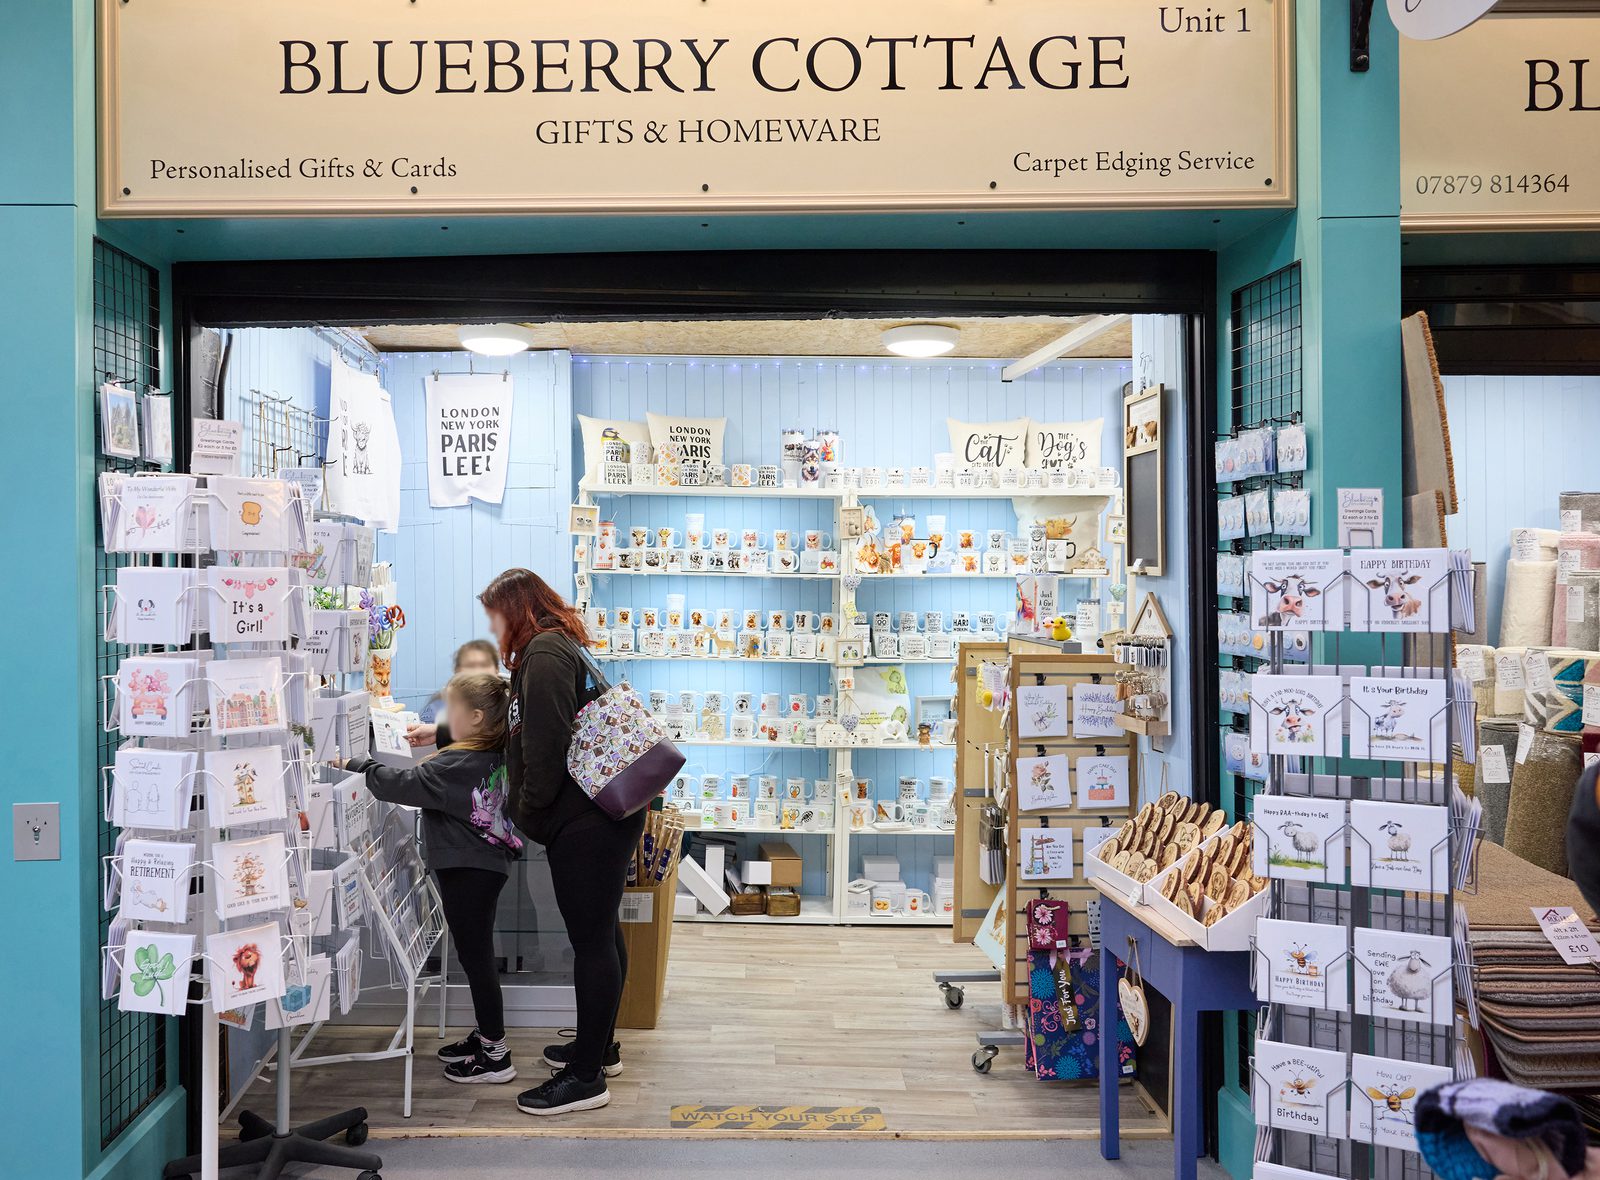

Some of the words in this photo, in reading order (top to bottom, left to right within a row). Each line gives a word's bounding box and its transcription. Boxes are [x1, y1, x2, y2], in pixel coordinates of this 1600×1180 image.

[1159, 7, 1226, 33] Unit
[1237, 8, 1251, 32] 1
[279, 39, 729, 95] BLUEBERRY
[752, 34, 1129, 92] COTTAGE
[536, 120, 633, 144] GIFTS
[644, 121, 667, 143] &
[679, 118, 880, 143] HOMEWARE
[150, 158, 292, 180] Personalised
[299, 157, 354, 179] Gifts
[363, 159, 383, 178] &
[392, 157, 456, 178] Cards
[1014, 152, 1088, 178] Carpet
[1096, 151, 1171, 178] Edging
[1178, 151, 1254, 171] Service
[1416, 175, 1482, 195] 07879
[1490, 174, 1570, 194] 814364
[442, 407, 500, 418] LONDON
[441, 421, 465, 430] NEW
[470, 420, 499, 429] YORK
[669, 426, 711, 436] LONDON
[442, 432, 497, 453] PARIS
[690, 436, 711, 444] YORK
[1038, 432, 1088, 461] Dog's
[677, 444, 711, 459] ARIS
[965, 433, 1019, 467] Cat
[1360, 560, 1387, 569] HAPPY
[1391, 559, 1431, 569] BIRTHDAY
[232, 601, 254, 615] It's
[257, 604, 263, 613] a
[236, 619, 263, 634] Girl!
[1376, 686, 1393, 694] Your
[1395, 686, 1428, 696] Birthday
[1263, 808, 1279, 816] Happy
[1280, 809, 1310, 818] BAA-thday
[130, 857, 147, 866] Happy
[153, 858, 174, 868] Relaxing
[130, 866, 175, 879] RETIREMENT
[1412, 866, 1422, 875] Day
[1367, 949, 1397, 961] Sending
[1568, 944, 1589, 953] £10
[1058, 969, 1071, 989] You
[1275, 975, 1293, 984] HAPPY
[1296, 977, 1324, 988] BIRTHDAY
[1060, 989, 1071, 1005] For
[1363, 994, 1393, 1006] bithday
[1063, 1005, 1077, 1025] Just
[1270, 1061, 1286, 1072] Have
[1292, 1058, 1325, 1079] BEE-utiful
[681, 1112, 753, 1121] WATCH
[758, 1112, 818, 1122] YOUR
[824, 1114, 875, 1123] STEP
[1276, 1108, 1319, 1126] Birthday
